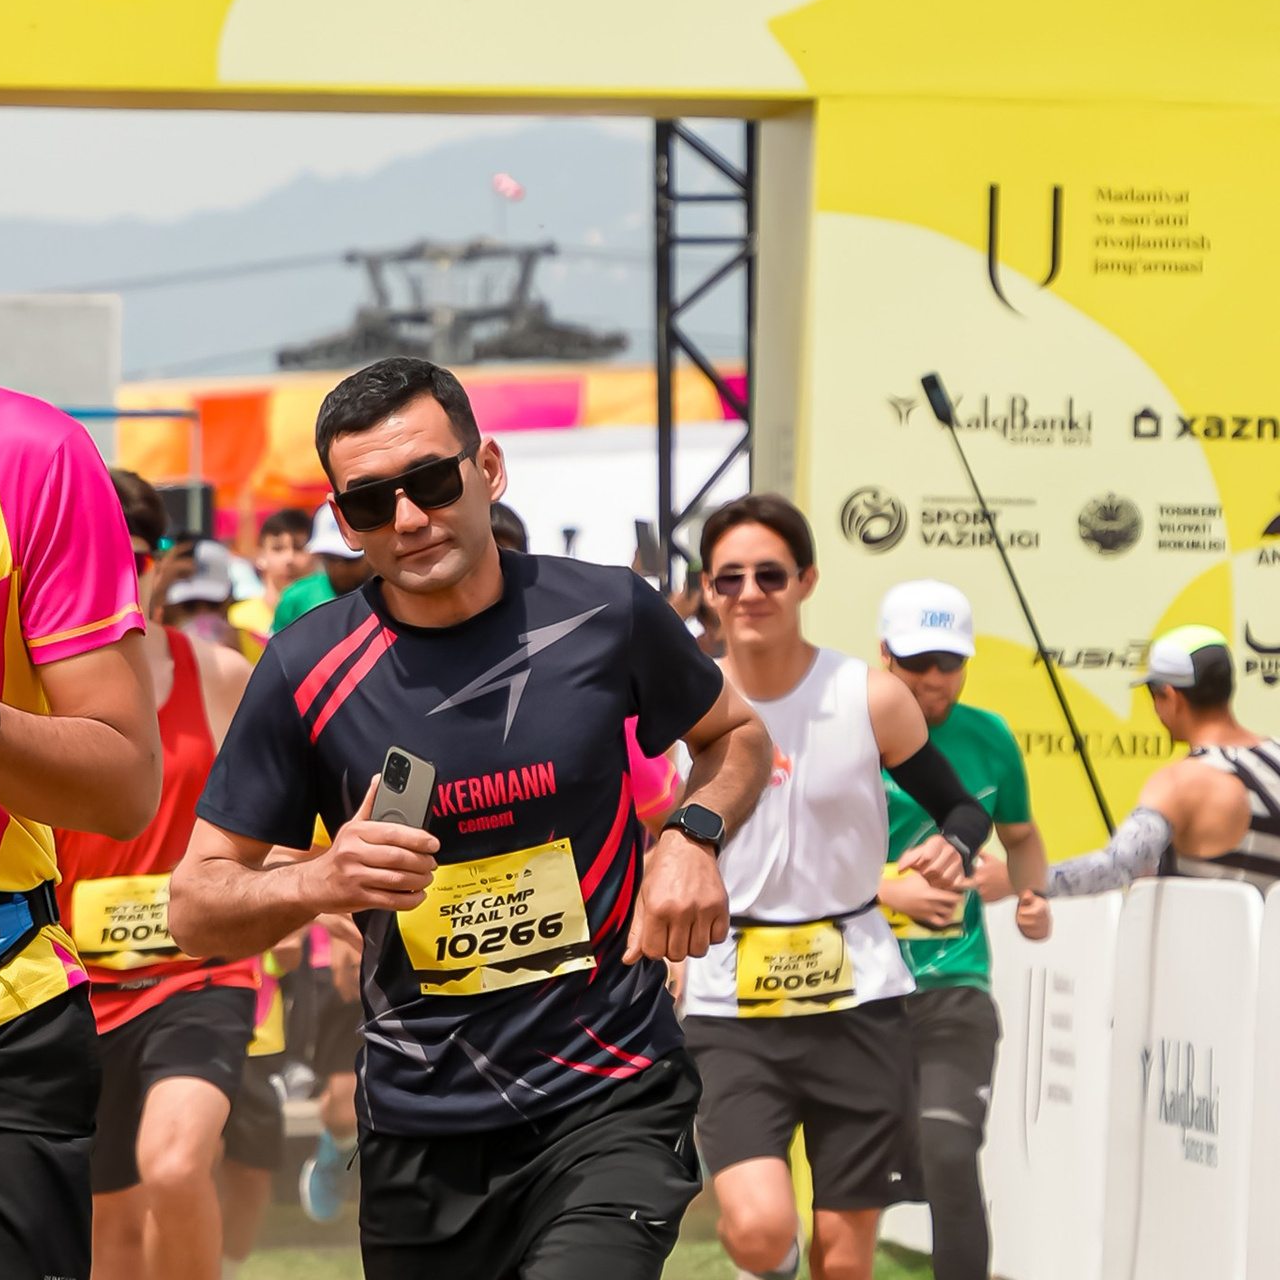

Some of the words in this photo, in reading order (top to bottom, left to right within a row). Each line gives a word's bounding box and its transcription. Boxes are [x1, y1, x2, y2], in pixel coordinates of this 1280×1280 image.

[922, 531, 1040, 548] VAZIRIGI
[432, 760, 556, 817] KERMANN
[458, 810, 515, 834] cement
[439, 900, 477, 917] SKY
[481, 888, 535, 909] CAMP
[450, 909, 504, 928] TRAIL
[509, 903, 528, 917] 10
[101, 924, 170, 945] 1004
[435, 911, 565, 961] 10266
